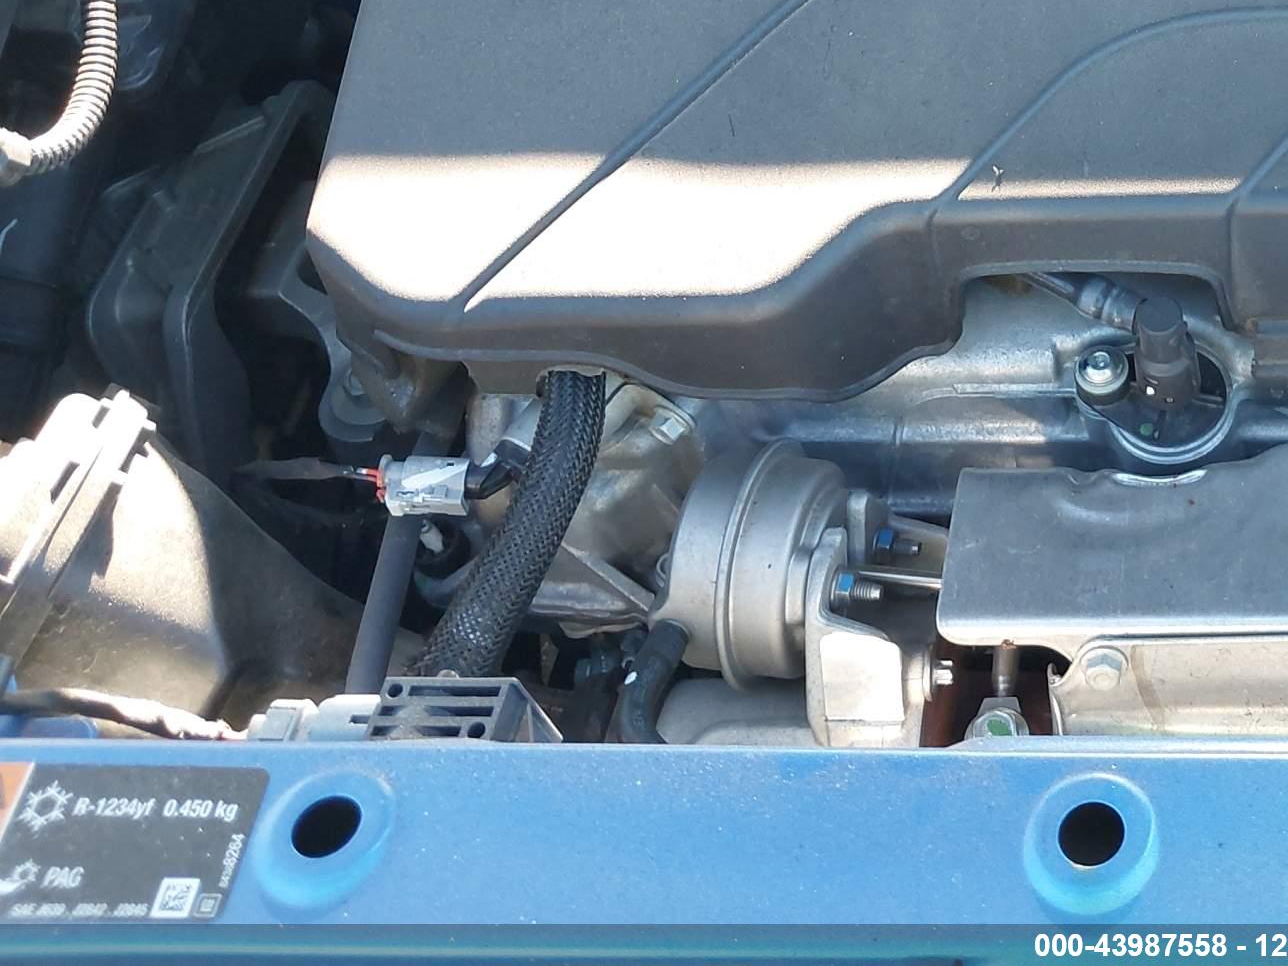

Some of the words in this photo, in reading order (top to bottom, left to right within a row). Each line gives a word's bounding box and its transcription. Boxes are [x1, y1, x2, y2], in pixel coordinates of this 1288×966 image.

[72, 797, 156, 820] R-1234yf
[163, 799, 213, 818] 0.450
[214, 800, 239, 823] kg
[41, 866, 85, 888] PAG
